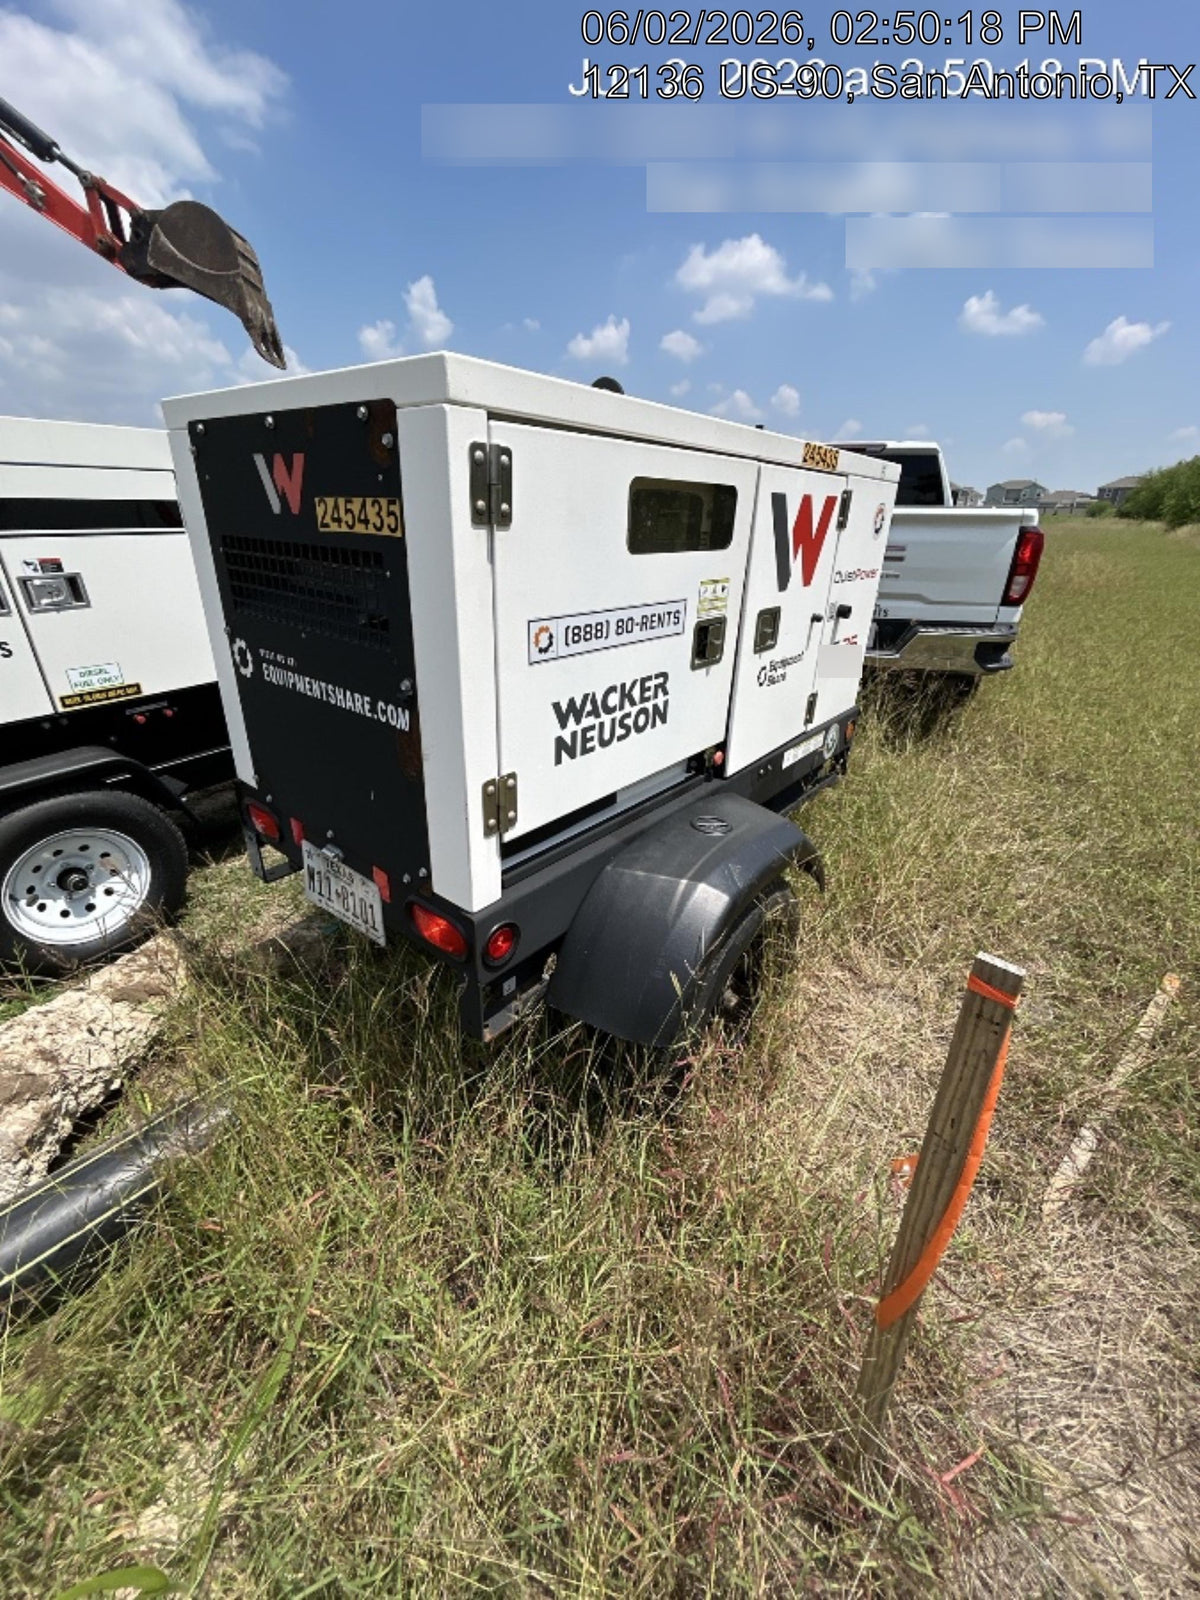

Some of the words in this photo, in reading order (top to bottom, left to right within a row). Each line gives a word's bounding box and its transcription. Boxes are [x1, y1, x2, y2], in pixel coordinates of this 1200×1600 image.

[318, 499, 400, 532] 245435
[565, 620, 610, 647] (888)
[615, 609, 681, 635] 80-RENTS
[262, 662, 410, 732] EQUIPMENTSHARE.COM
[551, 671, 669, 731] WACKER
[554, 699, 669, 767] NEUSON
